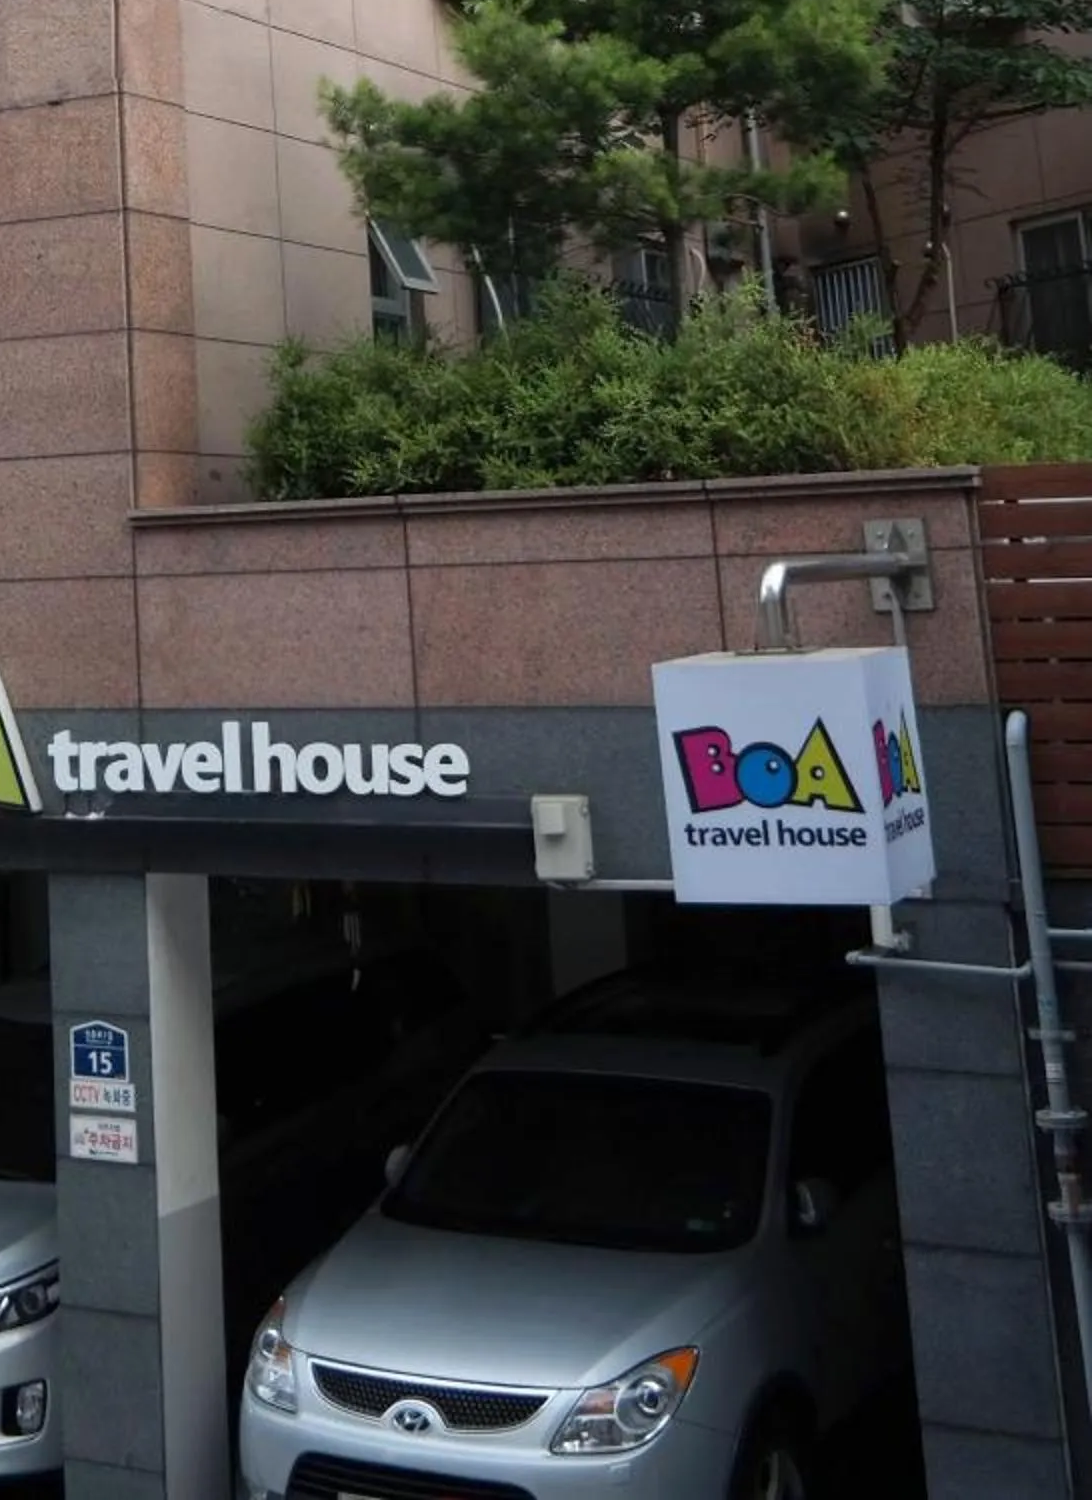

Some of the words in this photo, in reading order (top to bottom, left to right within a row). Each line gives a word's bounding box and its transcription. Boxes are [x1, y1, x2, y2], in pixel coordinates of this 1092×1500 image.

[48, 721, 242, 792] travel
[251, 721, 470, 796] house
[684, 820, 770, 846] travel
[776, 820, 867, 846] house
[88, 1051, 113, 1074] 15
